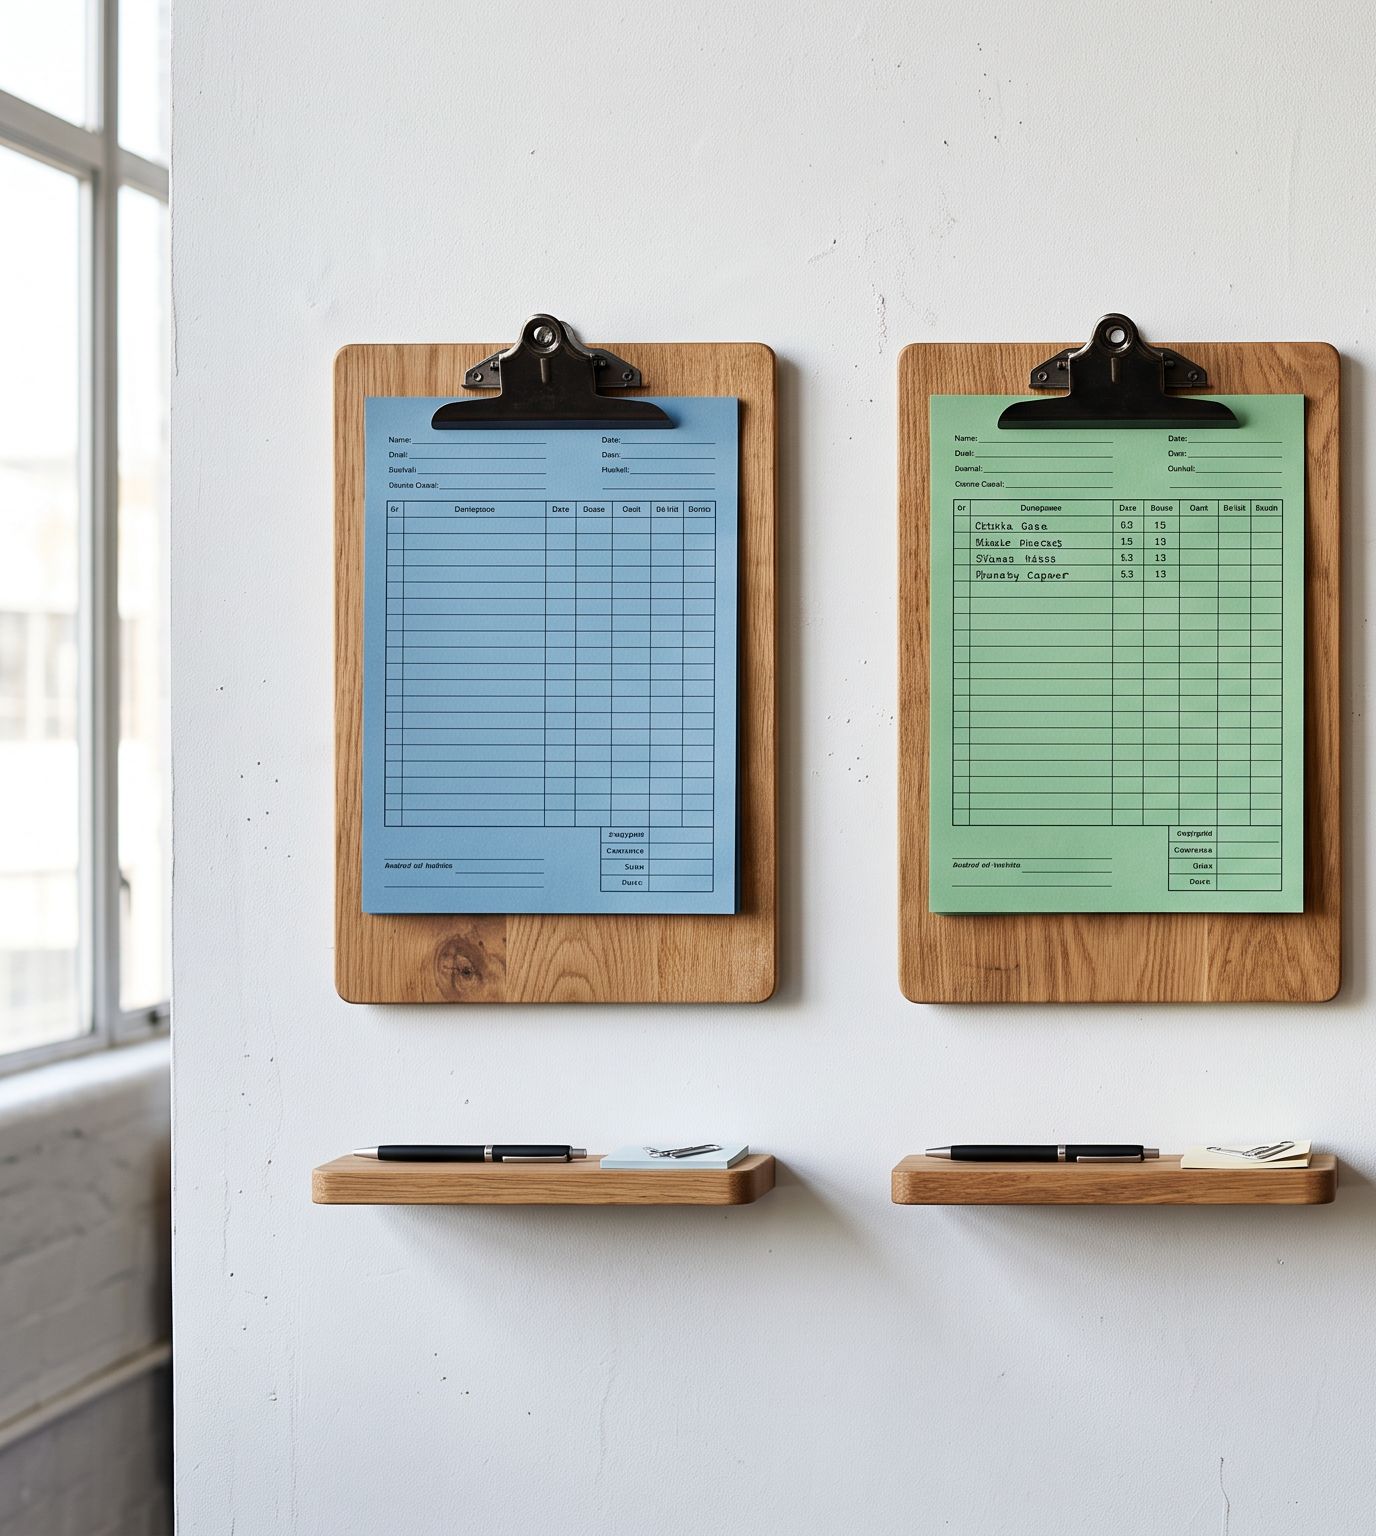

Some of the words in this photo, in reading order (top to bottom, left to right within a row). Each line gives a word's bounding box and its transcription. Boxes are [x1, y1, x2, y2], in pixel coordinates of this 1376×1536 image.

[601, 436, 621, 444] Date:
[1154, 553, 1166, 562] 13
[1154, 570, 1166, 578] 13
